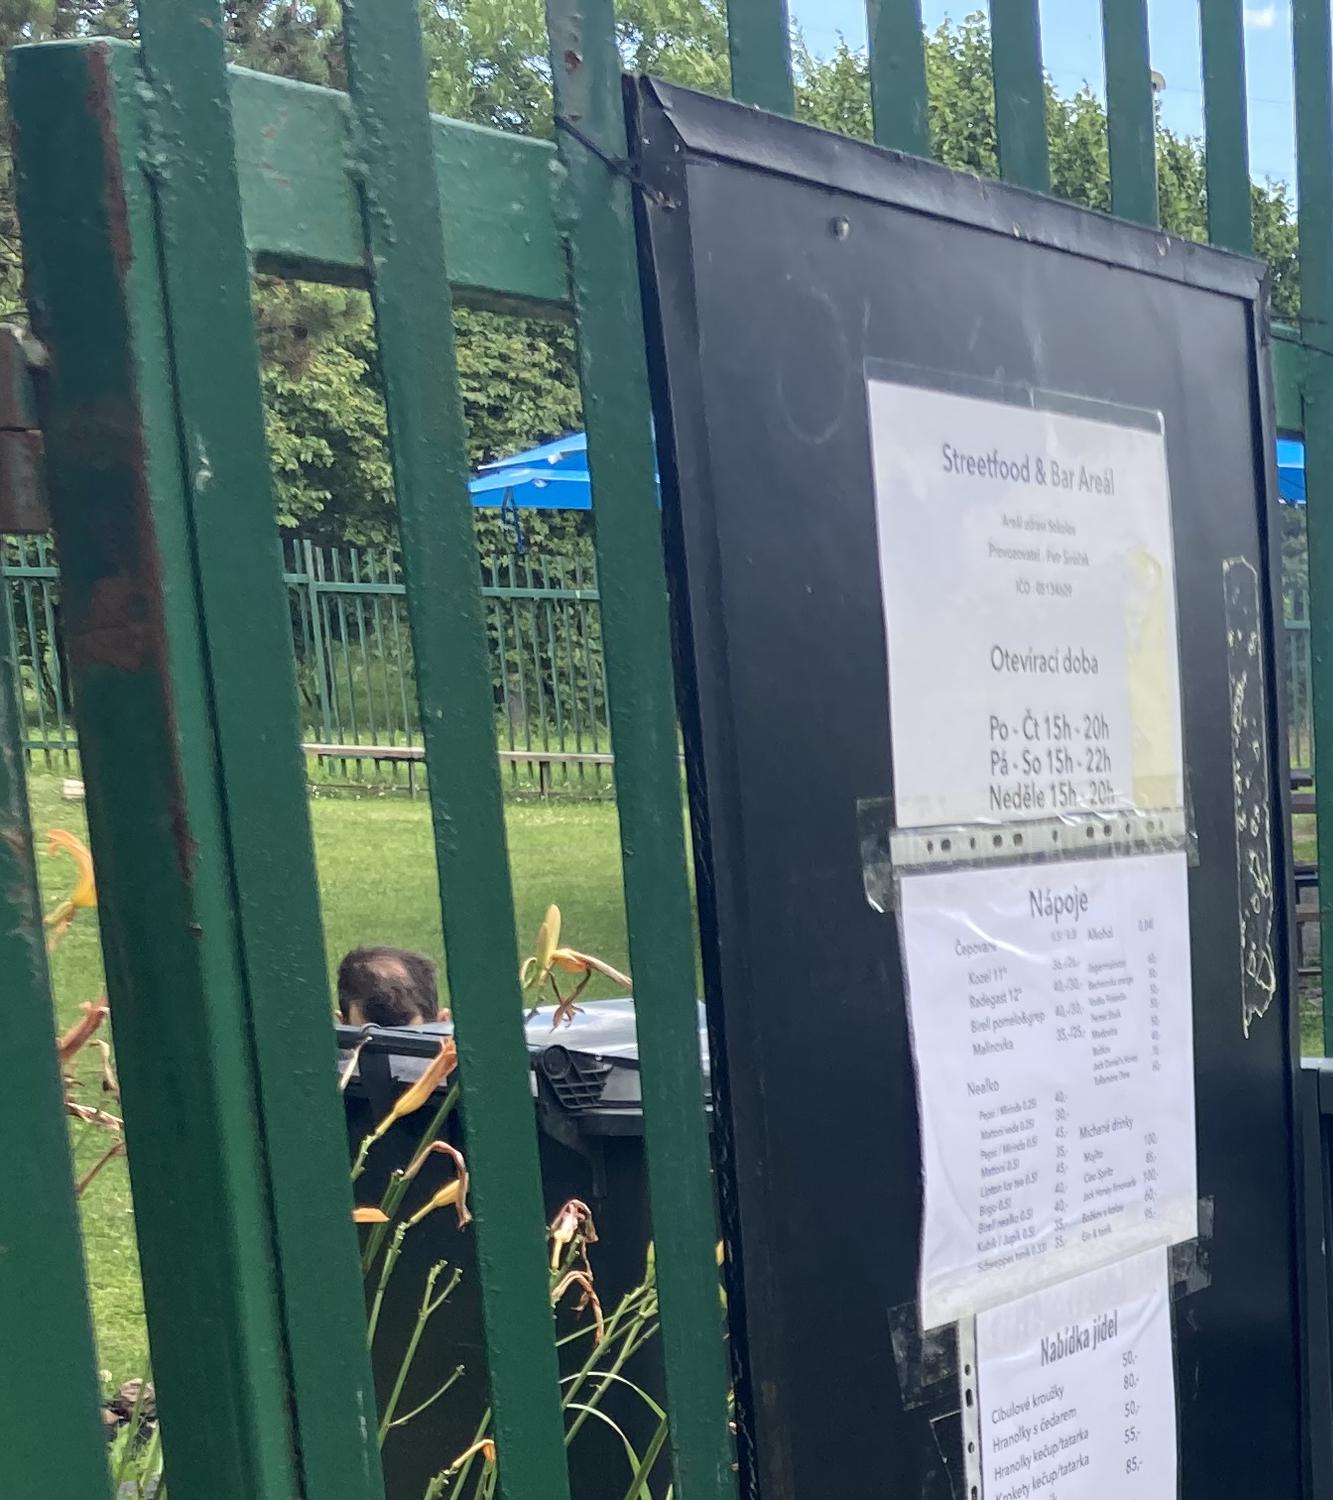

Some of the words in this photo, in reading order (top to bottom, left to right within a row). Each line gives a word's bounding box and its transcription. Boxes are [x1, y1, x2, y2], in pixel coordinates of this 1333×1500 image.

[942, 443, 1030, 484] Streetfood
[1035, 457, 1048, 486] &
[1050, 459, 1074, 490] Bar
[1078, 464, 1115, 496] Areál
[1063, 645, 1099, 675] doba
[990, 714, 1009, 741] Po
[1022, 705, 1041, 741] Čt
[1044, 711, 1072, 741] 15h
[1083, 712, 1110, 741] 20h
[990, 747, 1009, 776] Pá
[1022, 747, 1042, 776] So
[1047, 746, 1074, 775] 15h
[1086, 746, 1111, 775] 22h
[989, 779, 1045, 811] Neděle
[1050, 779, 1077, 808] 15h
[1029, 883, 1089, 924] Nápoje
[1040, 1323, 1090, 1367] Nabídka
[1092, 1309, 1118, 1350] jídel
[991, 1394, 1031, 1424] Cibulové
[992, 1424, 1032, 1453] Hranolky
[993, 1452, 1032, 1480] Hranolky
